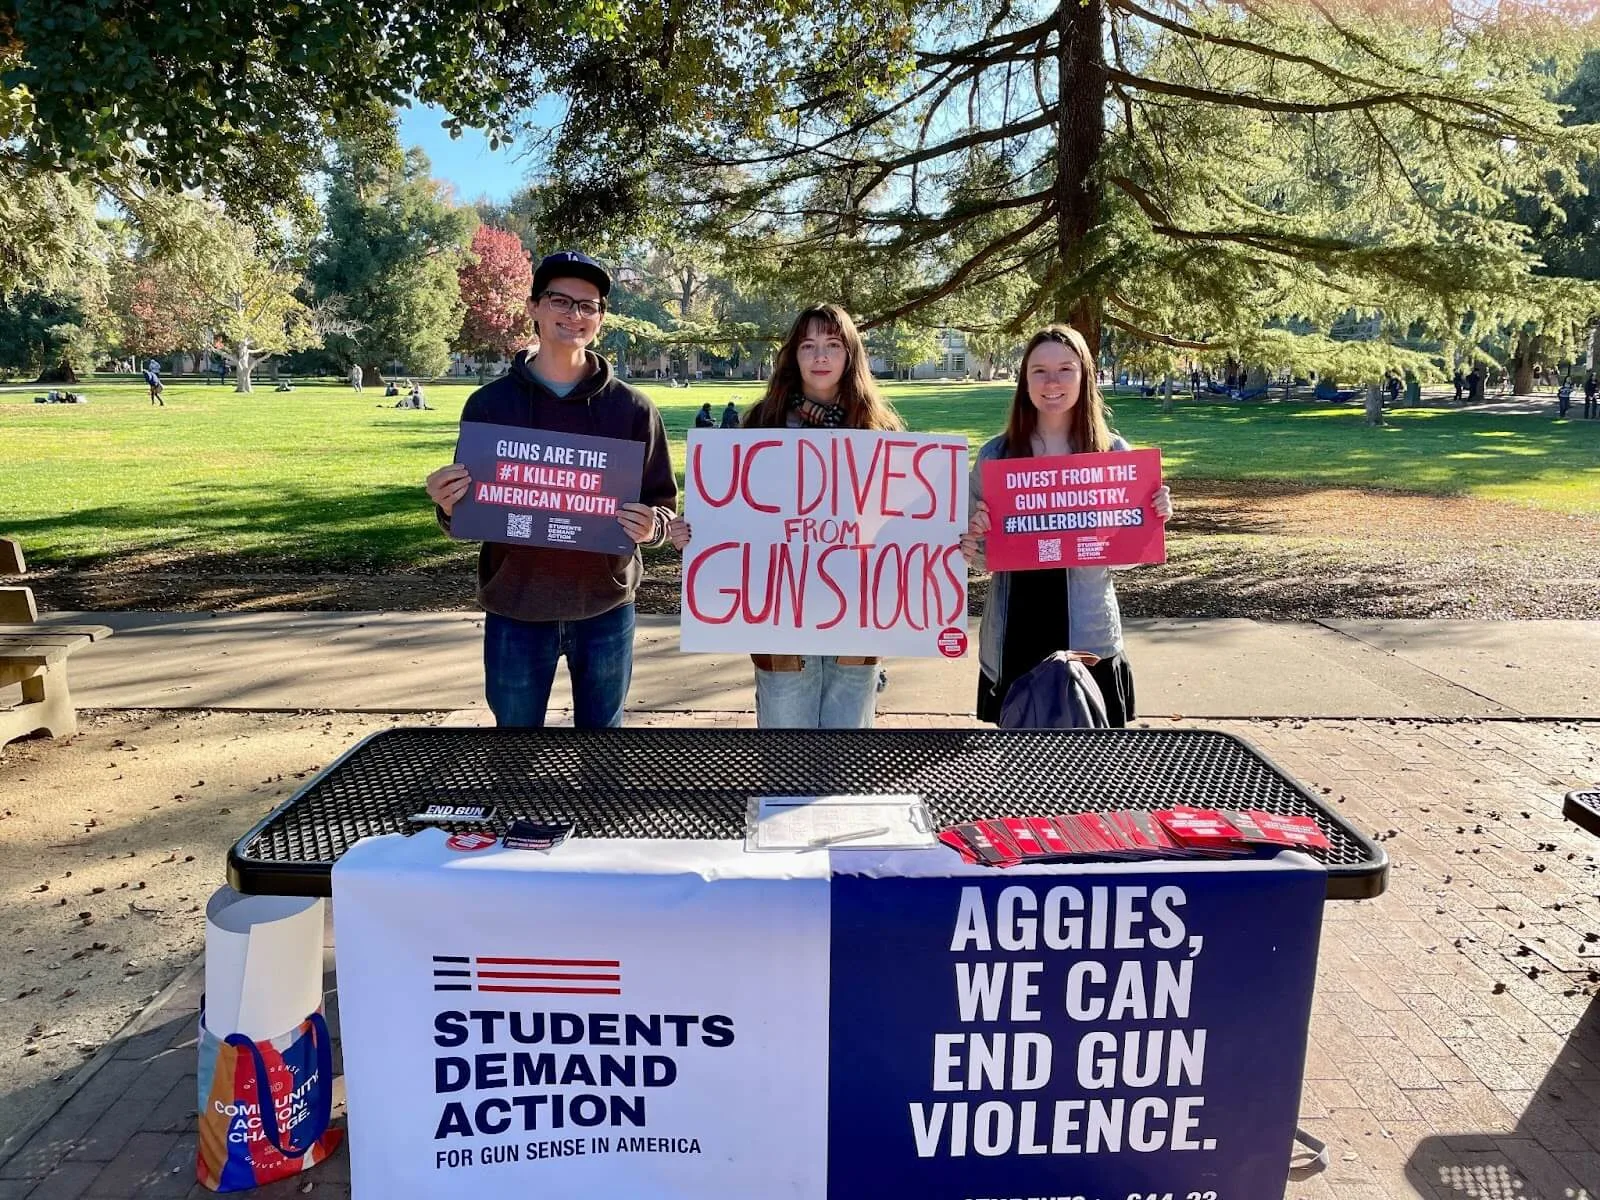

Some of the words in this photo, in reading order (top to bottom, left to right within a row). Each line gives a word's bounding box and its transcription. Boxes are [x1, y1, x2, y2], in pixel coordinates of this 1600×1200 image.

[496, 440, 540, 462] GUNS
[543, 446, 574, 466] ARE
[578, 450, 608, 469] THE
[499, 464, 519, 481] #1
[523, 466, 576, 489] KILLER
[579, 473, 601, 490] OF
[693, 440, 783, 513] UC
[797, 437, 968, 522] DIVEST
[1006, 470, 1058, 490] DIVEST
[1061, 467, 1104, 486] FROM
[1107, 464, 1137, 482] THE
[478, 484, 561, 510] AMERICAN
[565, 494, 616, 515] YOUTH
[1015, 492, 1047, 511] GUN
[1051, 488, 1130, 508] INDUSTRY.
[784, 518, 860, 544] FROM
[1005, 508, 1142, 533] #KILLERBUSINESS
[425, 804, 454, 815] END
[456, 806, 485, 816] GUN
[950, 885, 1204, 958] AGGIES,
[955, 961, 1044, 1022] WE
[1065, 960, 1194, 1022] CAN
[434, 1010, 736, 1048] STUDENTS
[435, 1052, 678, 1094] DEMAND
[932, 1032, 1053, 1092] END
[1077, 1029, 1208, 1090] GUN
[434, 1094, 646, 1140] ACTION
[908, 1096, 1218, 1158] VIOLENCE.
[436, 1149, 473, 1169] FOR
[480, 1145, 519, 1166] GUN
[526, 1138, 585, 1160] SENSE
[591, 1137, 610, 1154] IN
[616, 1137, 702, 1154] AMERICA
